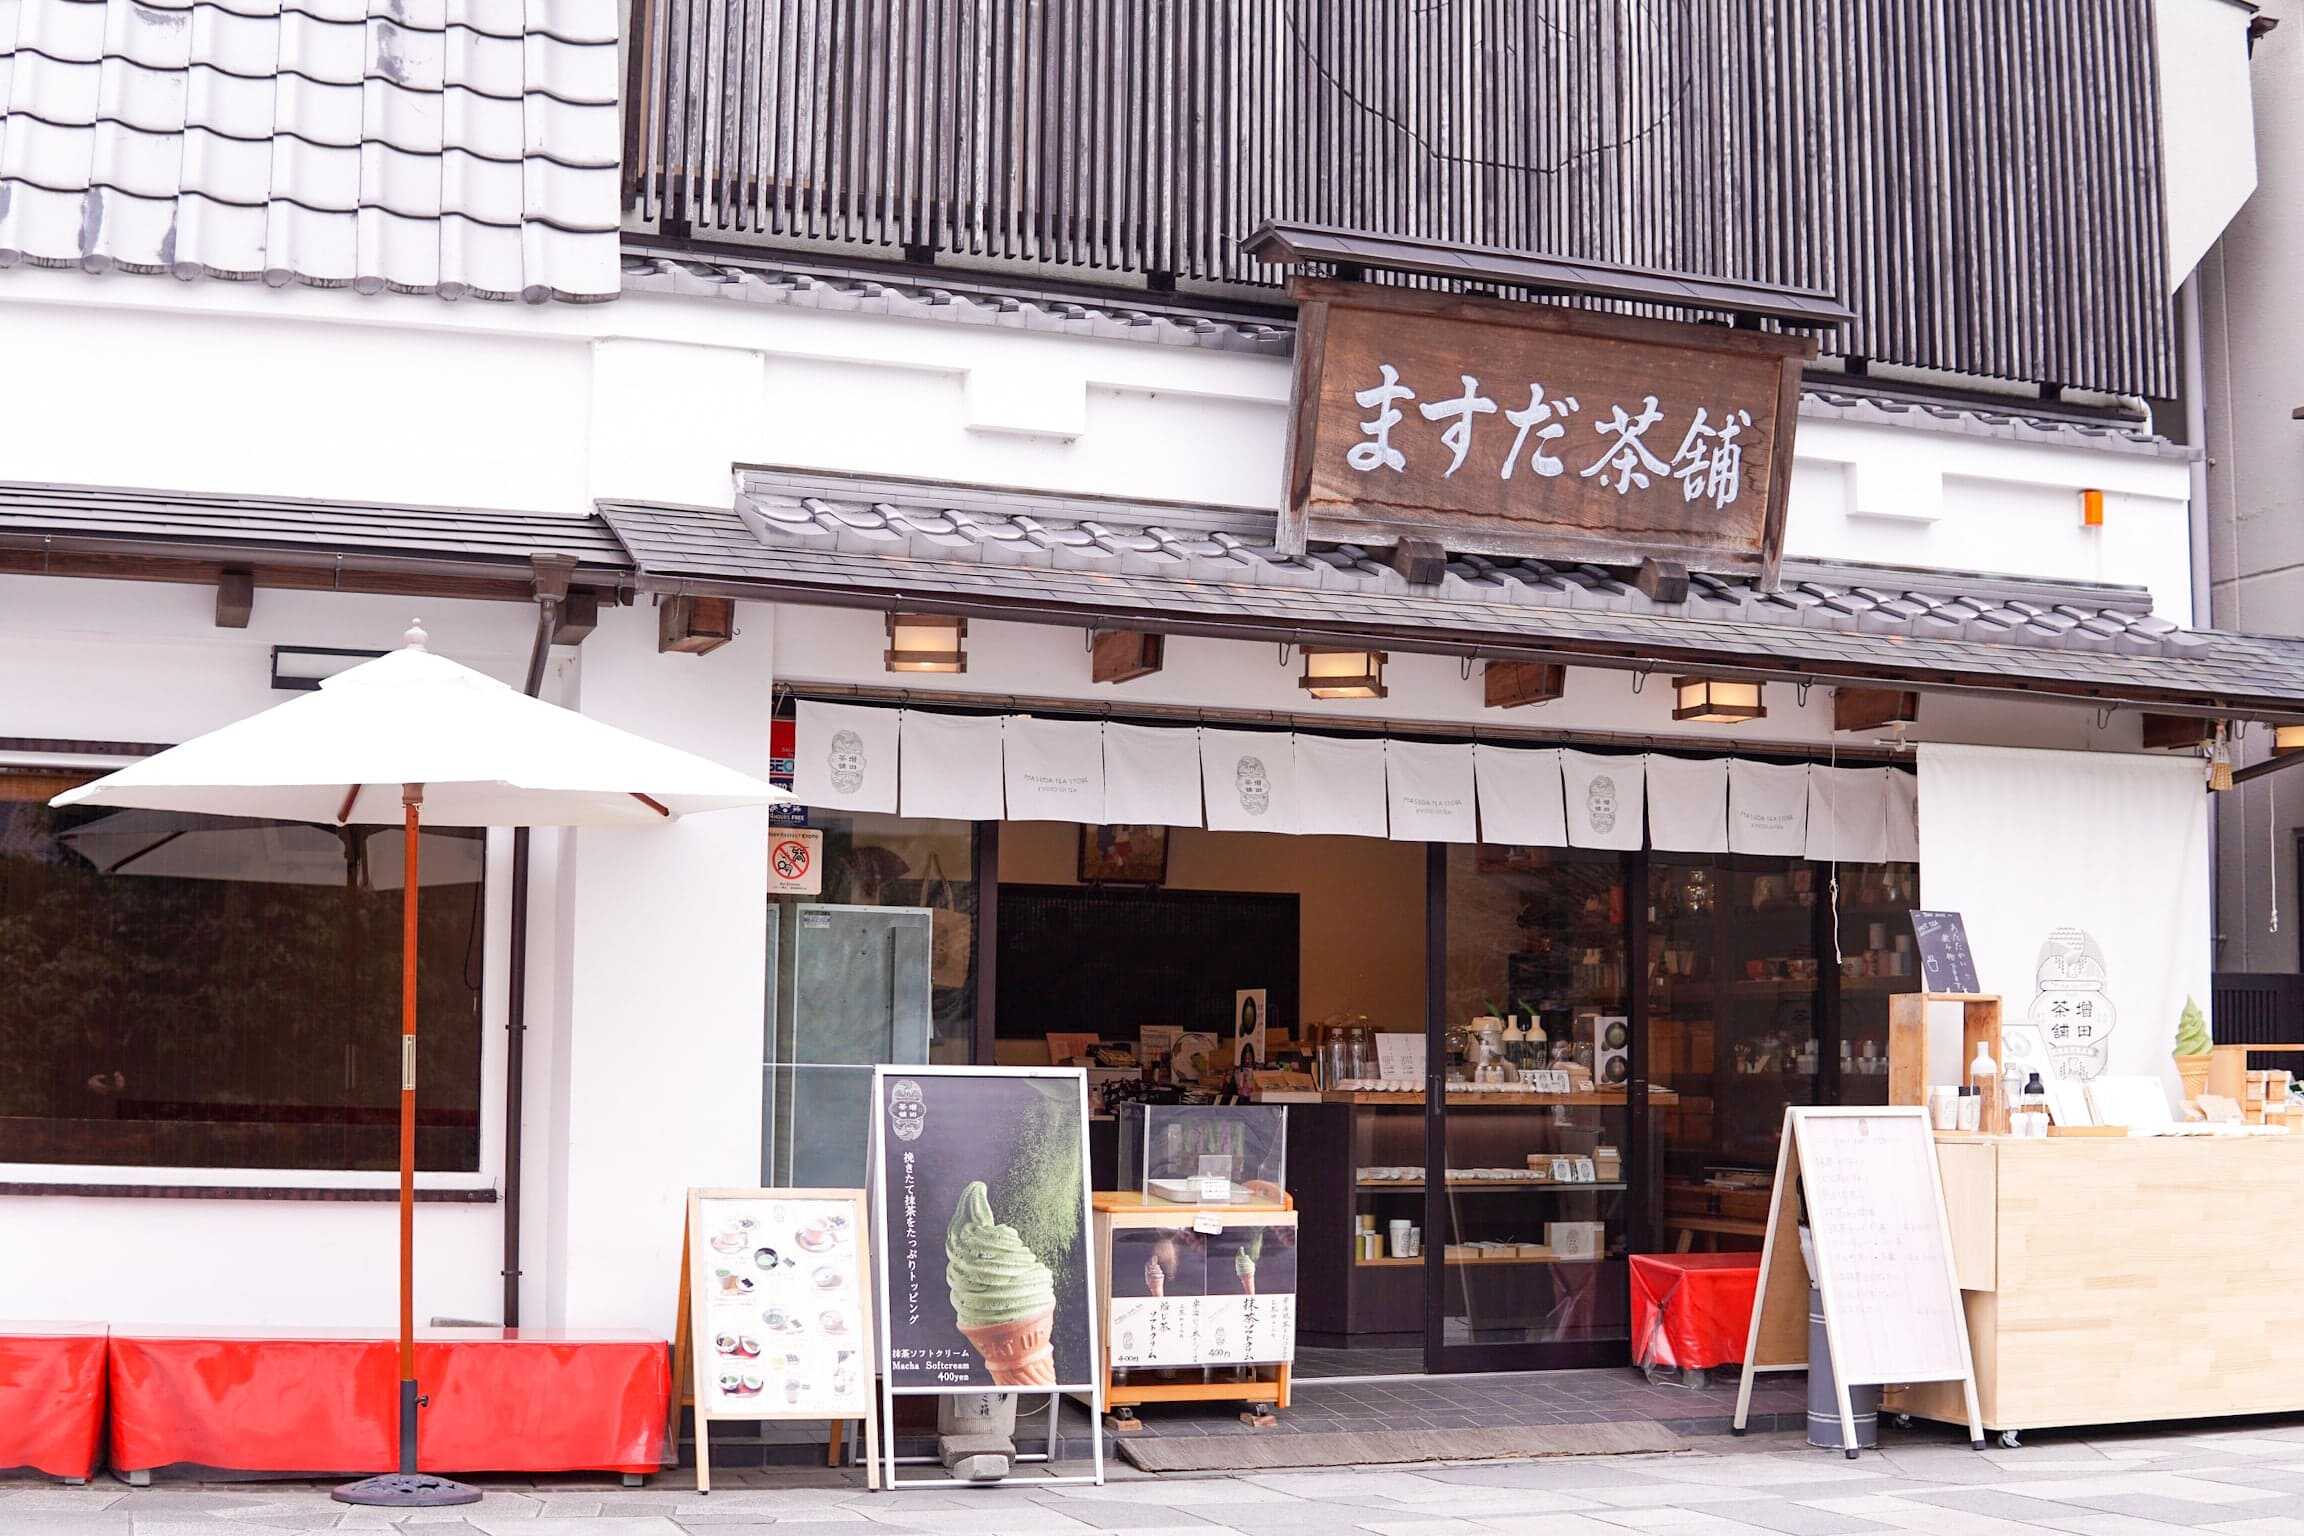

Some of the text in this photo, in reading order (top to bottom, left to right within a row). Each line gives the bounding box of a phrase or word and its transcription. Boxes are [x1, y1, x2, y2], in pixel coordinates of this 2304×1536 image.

[892, 1348, 970, 1359] 抹茶ソフトクリーム
[892, 1361, 970, 1370] Macha Softcream
[937, 1372, 970, 1383] 400yen
